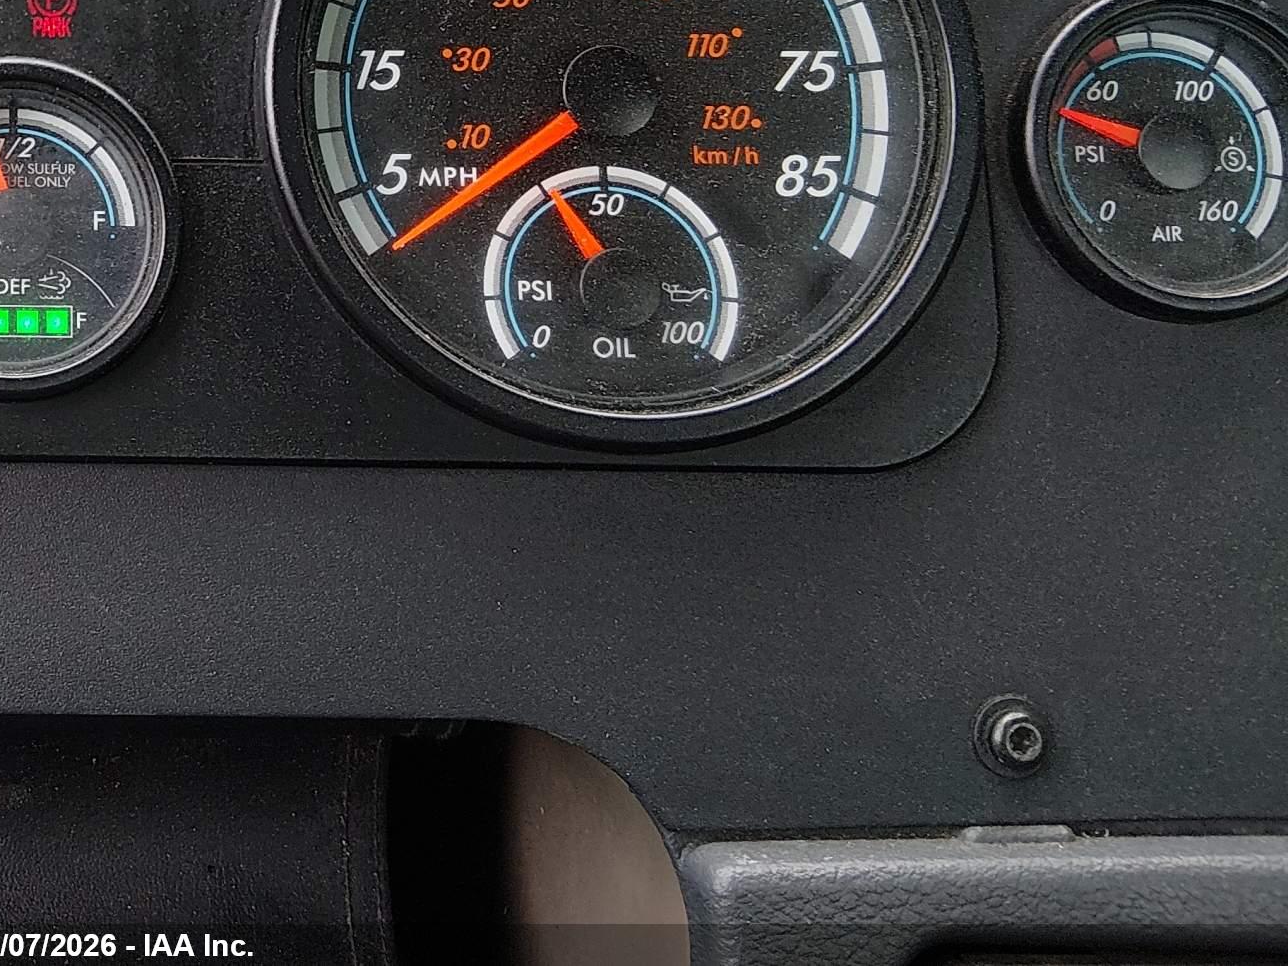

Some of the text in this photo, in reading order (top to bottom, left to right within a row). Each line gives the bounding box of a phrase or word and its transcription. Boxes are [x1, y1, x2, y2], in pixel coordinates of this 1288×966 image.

[32, 16, 72, 38] PARK
[687, 32, 730, 59] 110
[355, 50, 405, 91] 15
[451, 47, 492, 73] 30
[775, 50, 839, 92] 75
[1086, 79, 1119, 101] 60
[1174, 79, 1215, 102] 100
[701, 105, 751, 131] 130
[460, 124, 492, 150] 10
[1075, 145, 1105, 164] PSI
[27, 162, 76, 175] SULFUR
[376, 153, 479, 196] 5 MPH
[774, 155, 843, 198] 85
[6, 175, 31, 188] UEL
[34, 175, 72, 188] ONLY
[588, 192, 625, 217] 50
[1099, 200, 1116, 222] 0
[1198, 199, 1239, 222] 160
[93, 210, 107, 231] F
[1152, 226, 1184, 242] AIR
[518, 279, 553, 302] PSI
[76, 312, 88, 329] F
[661, 320, 705, 344] 100
[532, 325, 551, 349] 0
[592, 336, 636, 360] OIL
